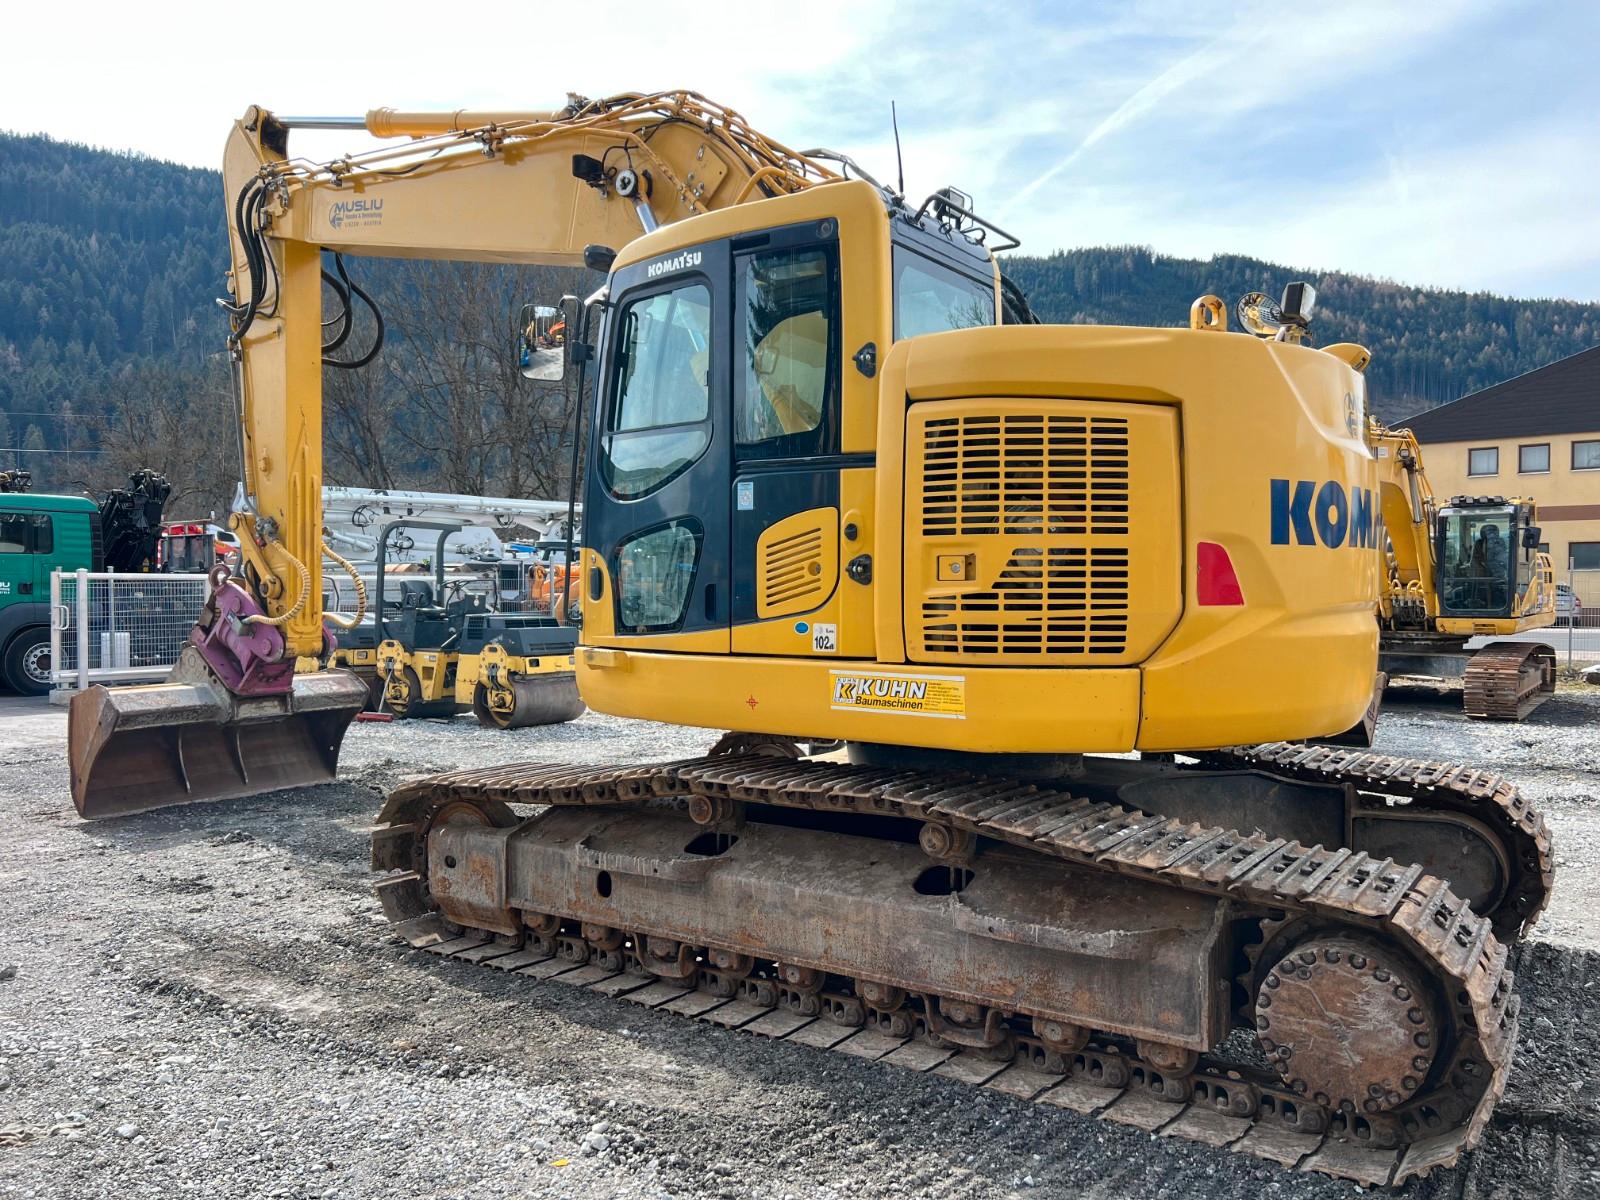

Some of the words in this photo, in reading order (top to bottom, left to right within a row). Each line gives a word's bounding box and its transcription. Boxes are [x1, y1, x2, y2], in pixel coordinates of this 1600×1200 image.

[334, 199, 383, 213] MUSLIU
[648, 251, 702, 278] KOMATSU
[857, 678, 928, 699] KUHN
[856, 696, 923, 710] Baumaschinen
